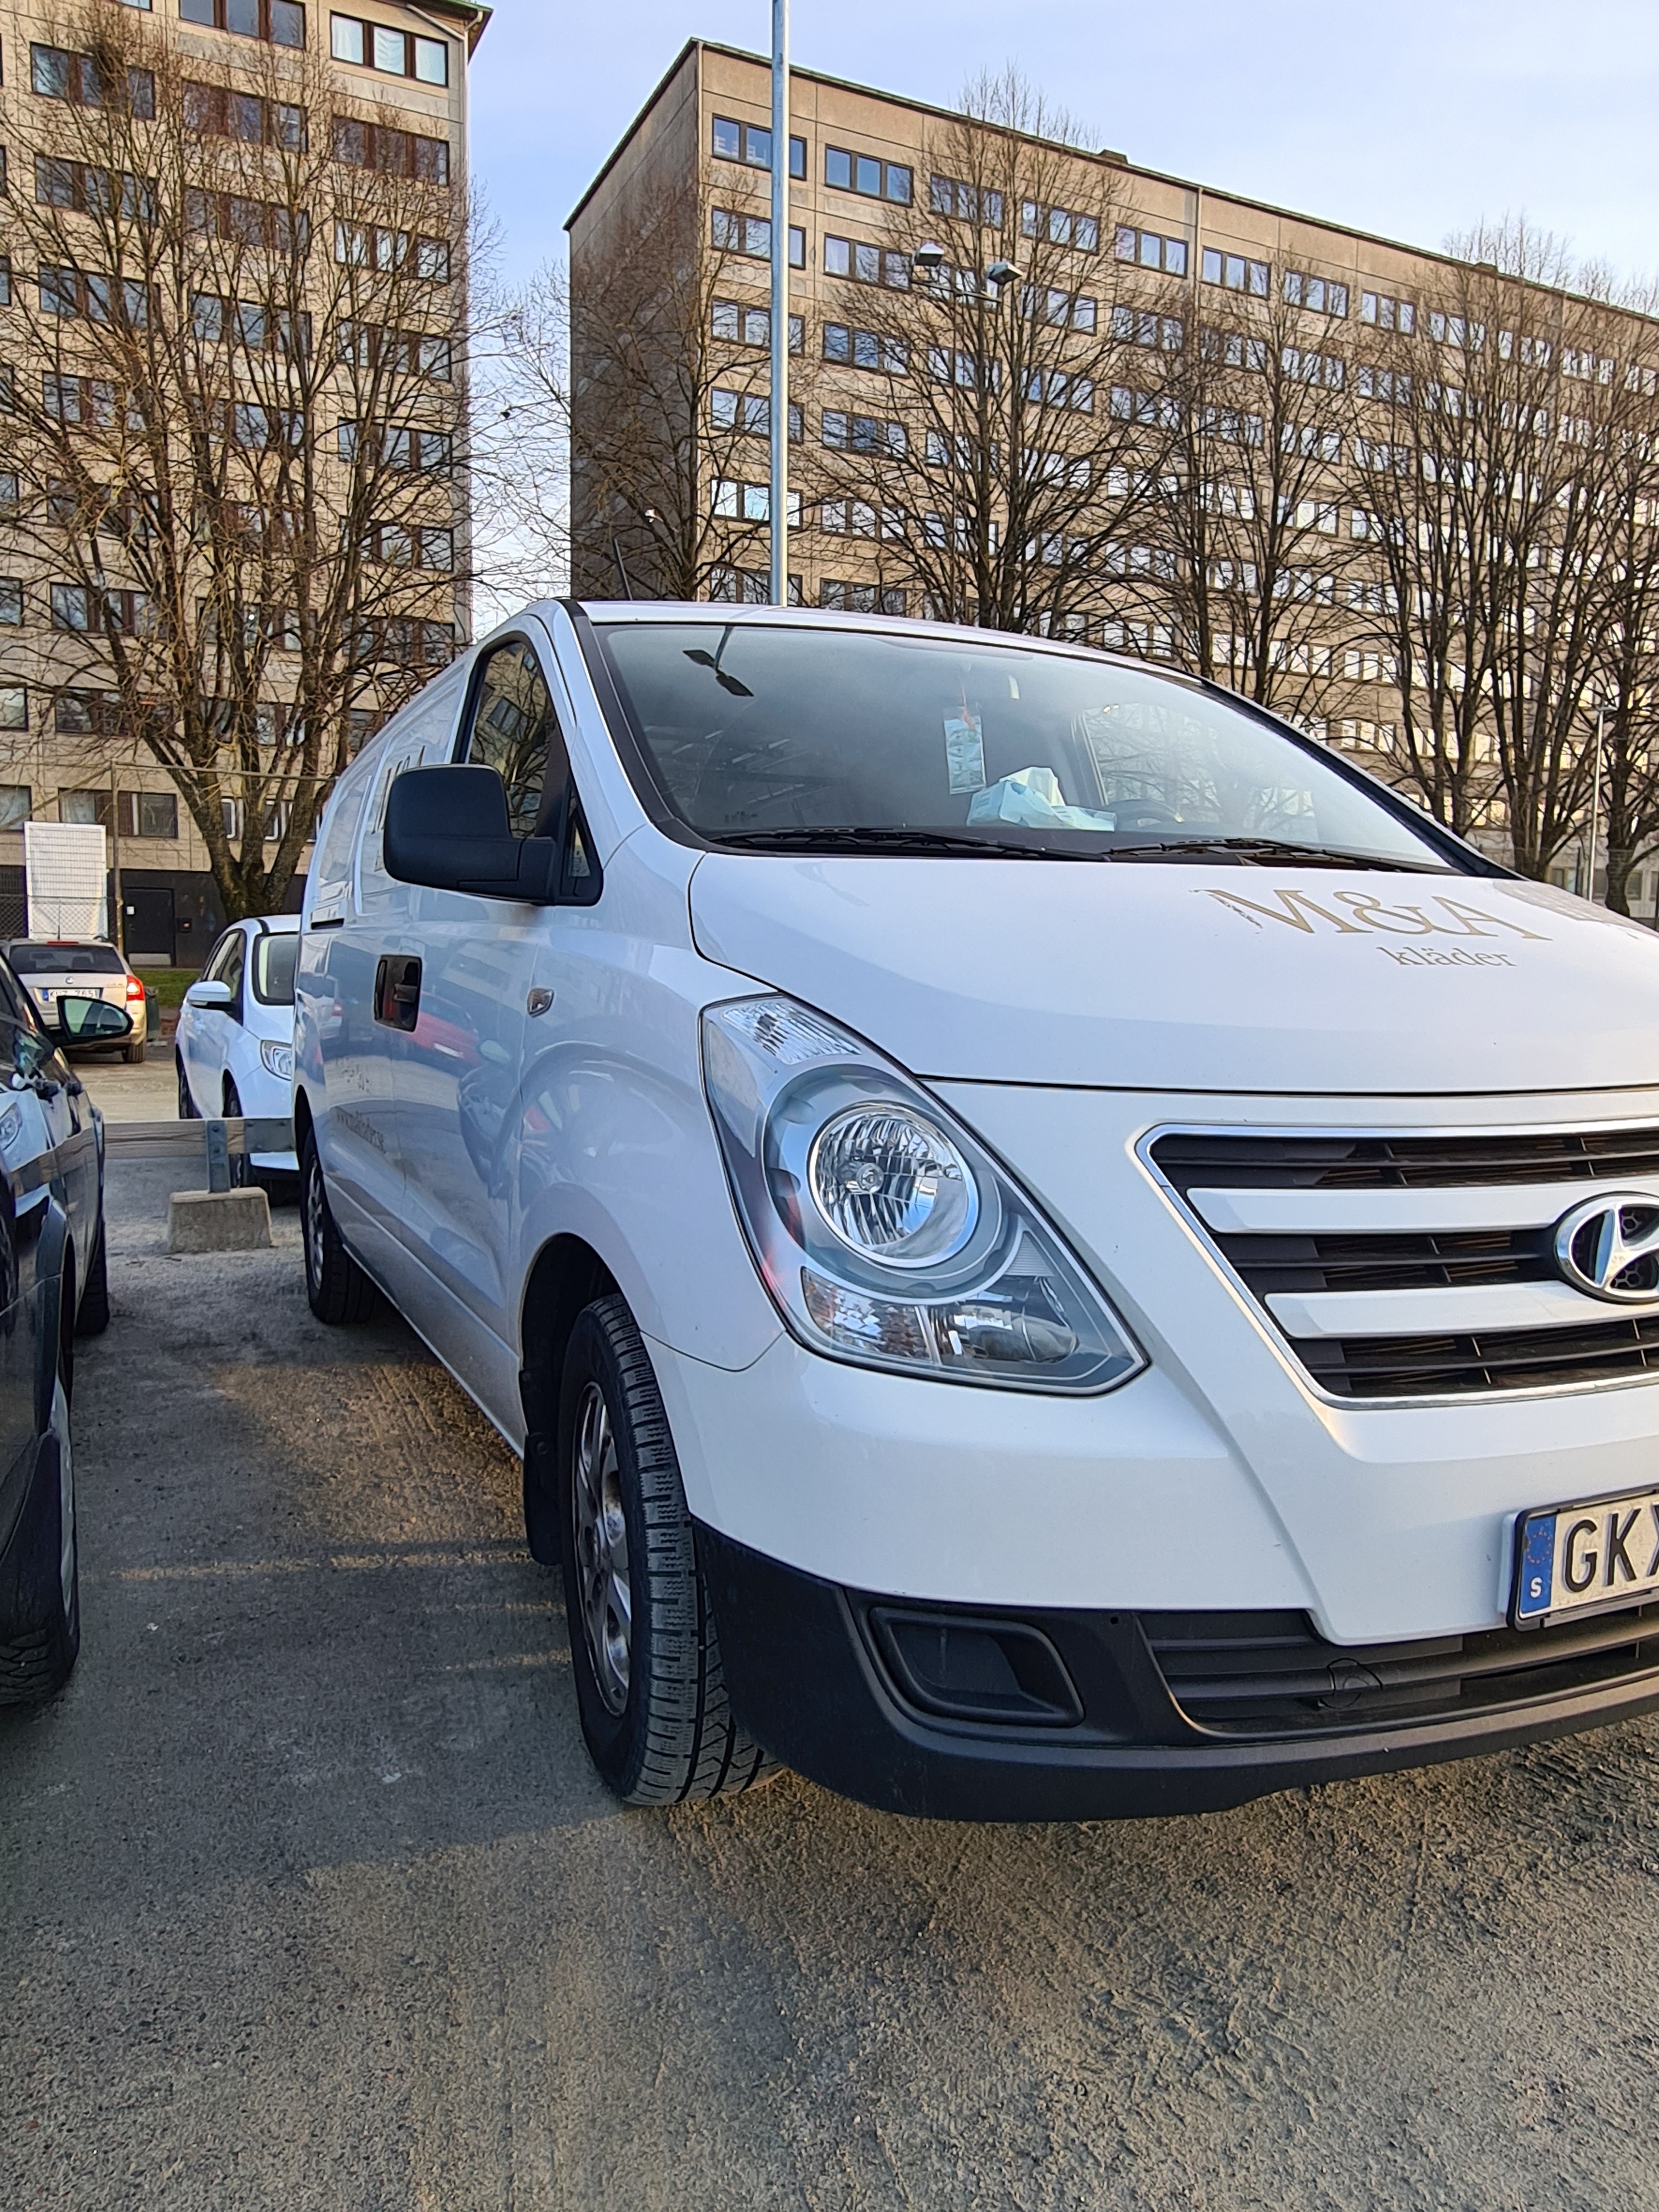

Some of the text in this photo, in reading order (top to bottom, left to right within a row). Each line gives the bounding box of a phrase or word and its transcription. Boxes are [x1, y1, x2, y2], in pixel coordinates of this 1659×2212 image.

[1189, 889, 1554, 941] M&A
[1375, 946, 1517, 967] kläder
[1530, 1577, 1543, 1598] S
